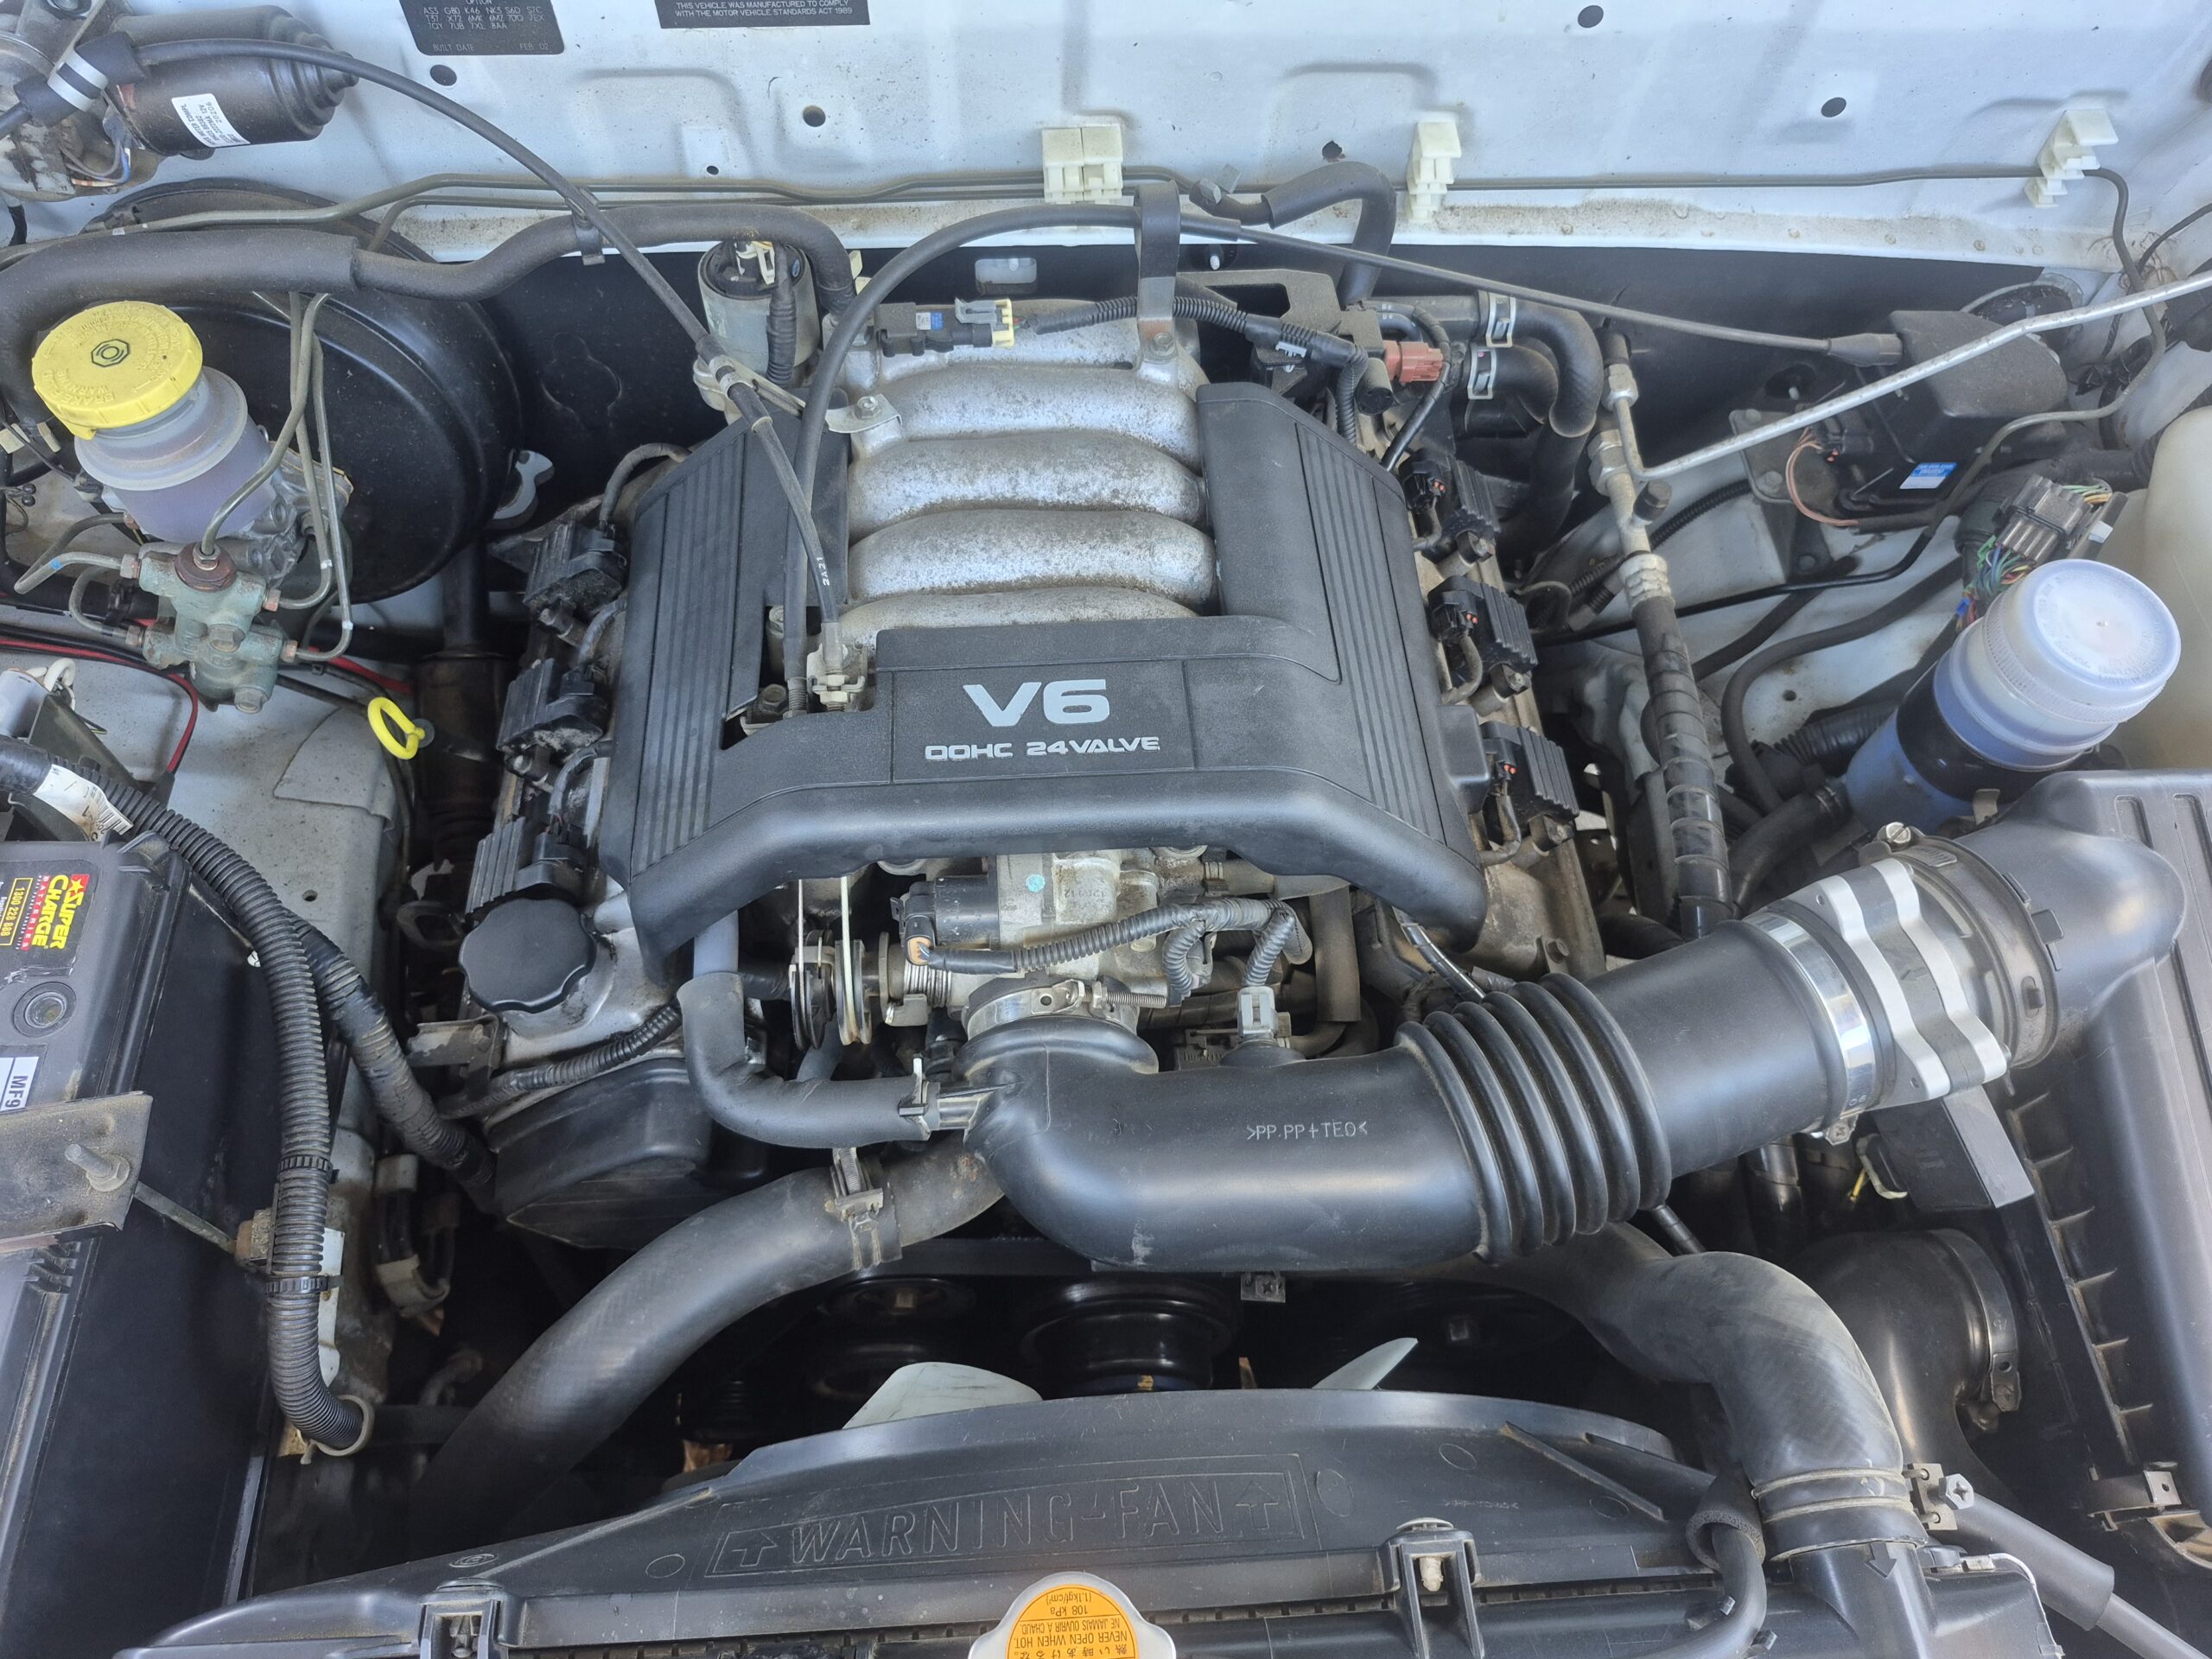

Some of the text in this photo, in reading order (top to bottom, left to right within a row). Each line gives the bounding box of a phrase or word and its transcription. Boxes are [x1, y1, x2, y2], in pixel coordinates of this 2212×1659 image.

[456, 43, 474, 52] DATE
[61, 391, 116, 405] BRAKE
[963, 678, 1110, 728] V6
[925, 743, 1014, 761] DOHC
[10, 887, 25, 906] 1300
[5, 906, 19, 921] 228
[22, 875, 50, 948] BATTERIES
[31, 874, 69, 946] CHARGE
[49, 891, 84, 950] SUPER
[1050, 1605, 1089, 1617] 108 kPa
[1055, 1620, 1079, 1632] OUVRIR
[1082, 1618, 1108, 1630] JAMAIS
[1111, 1618, 1120, 1629] NE
[1014, 1630, 1128, 1649] NEVER OPEN WHEN HOT.
